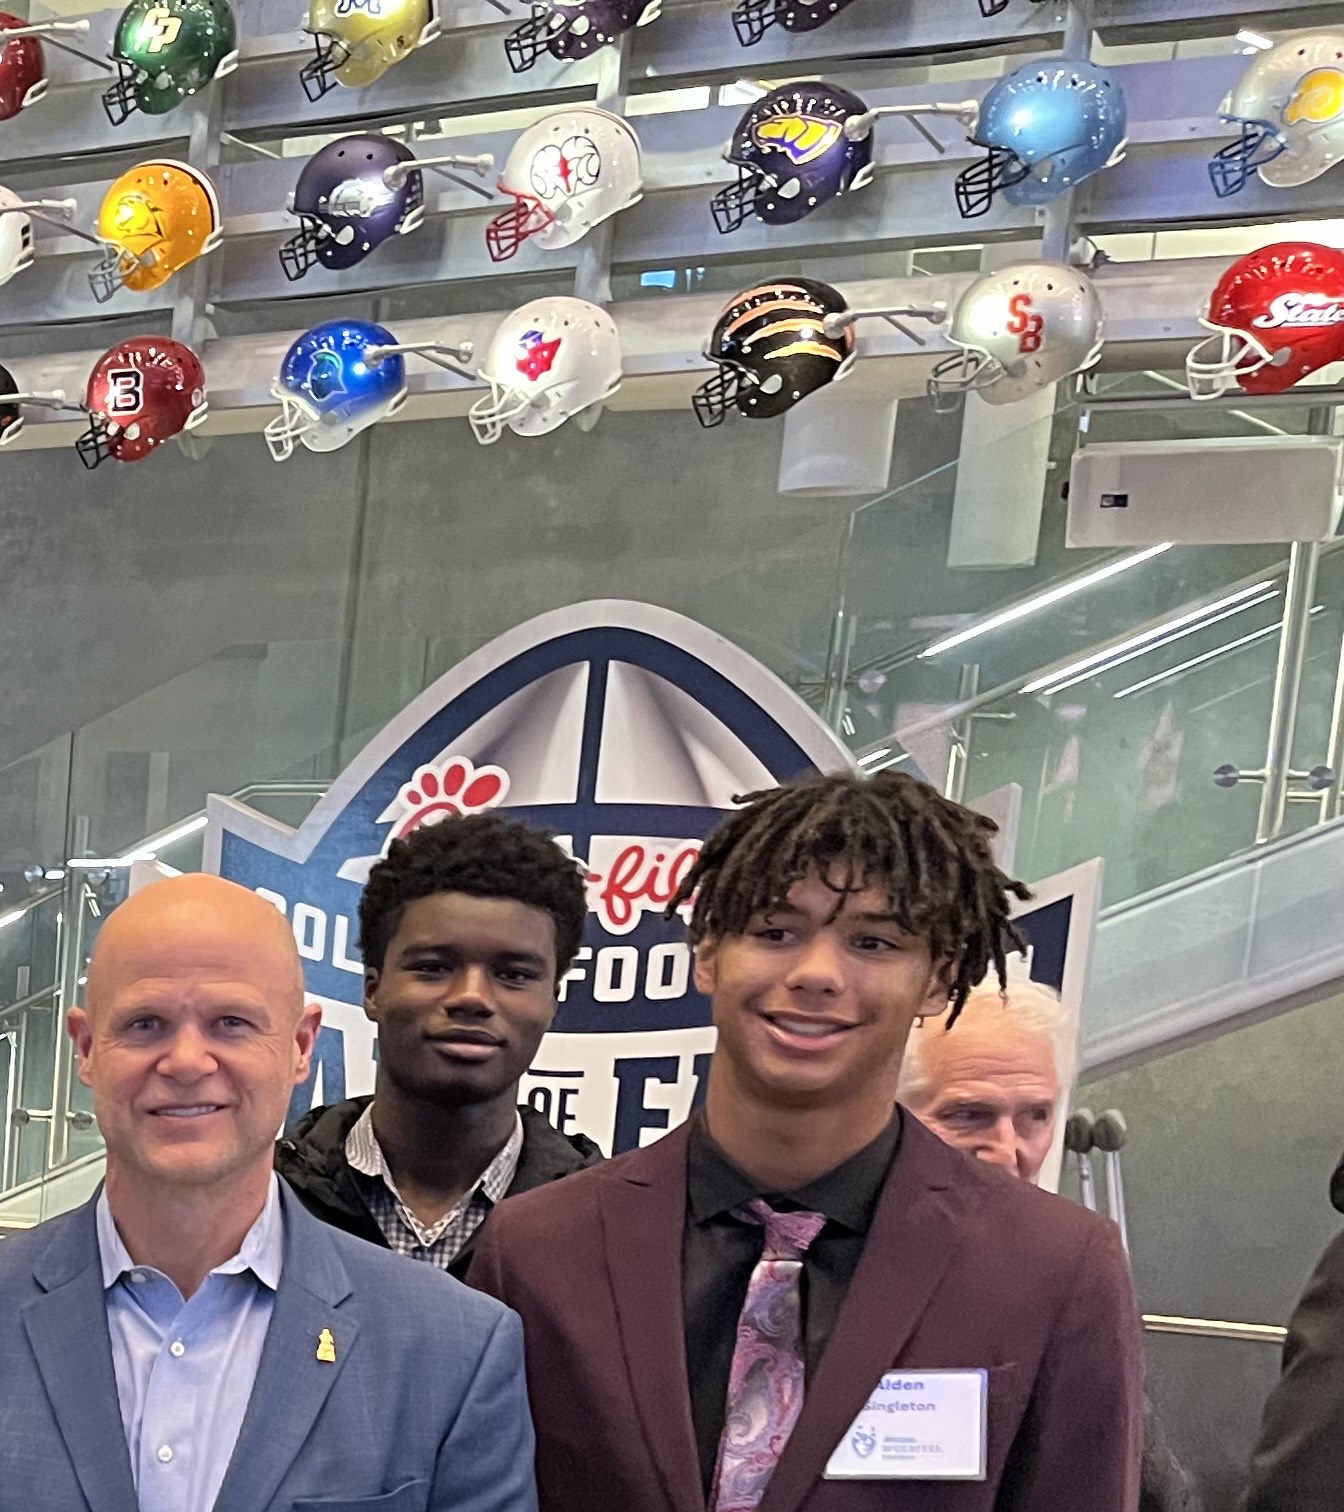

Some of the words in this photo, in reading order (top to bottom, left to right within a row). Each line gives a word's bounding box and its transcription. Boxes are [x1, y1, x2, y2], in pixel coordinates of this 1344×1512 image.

[1252, 292, 1344, 329] Stat
[107, 367, 144, 417] B
[862, 1400, 937, 1414] Singleton
